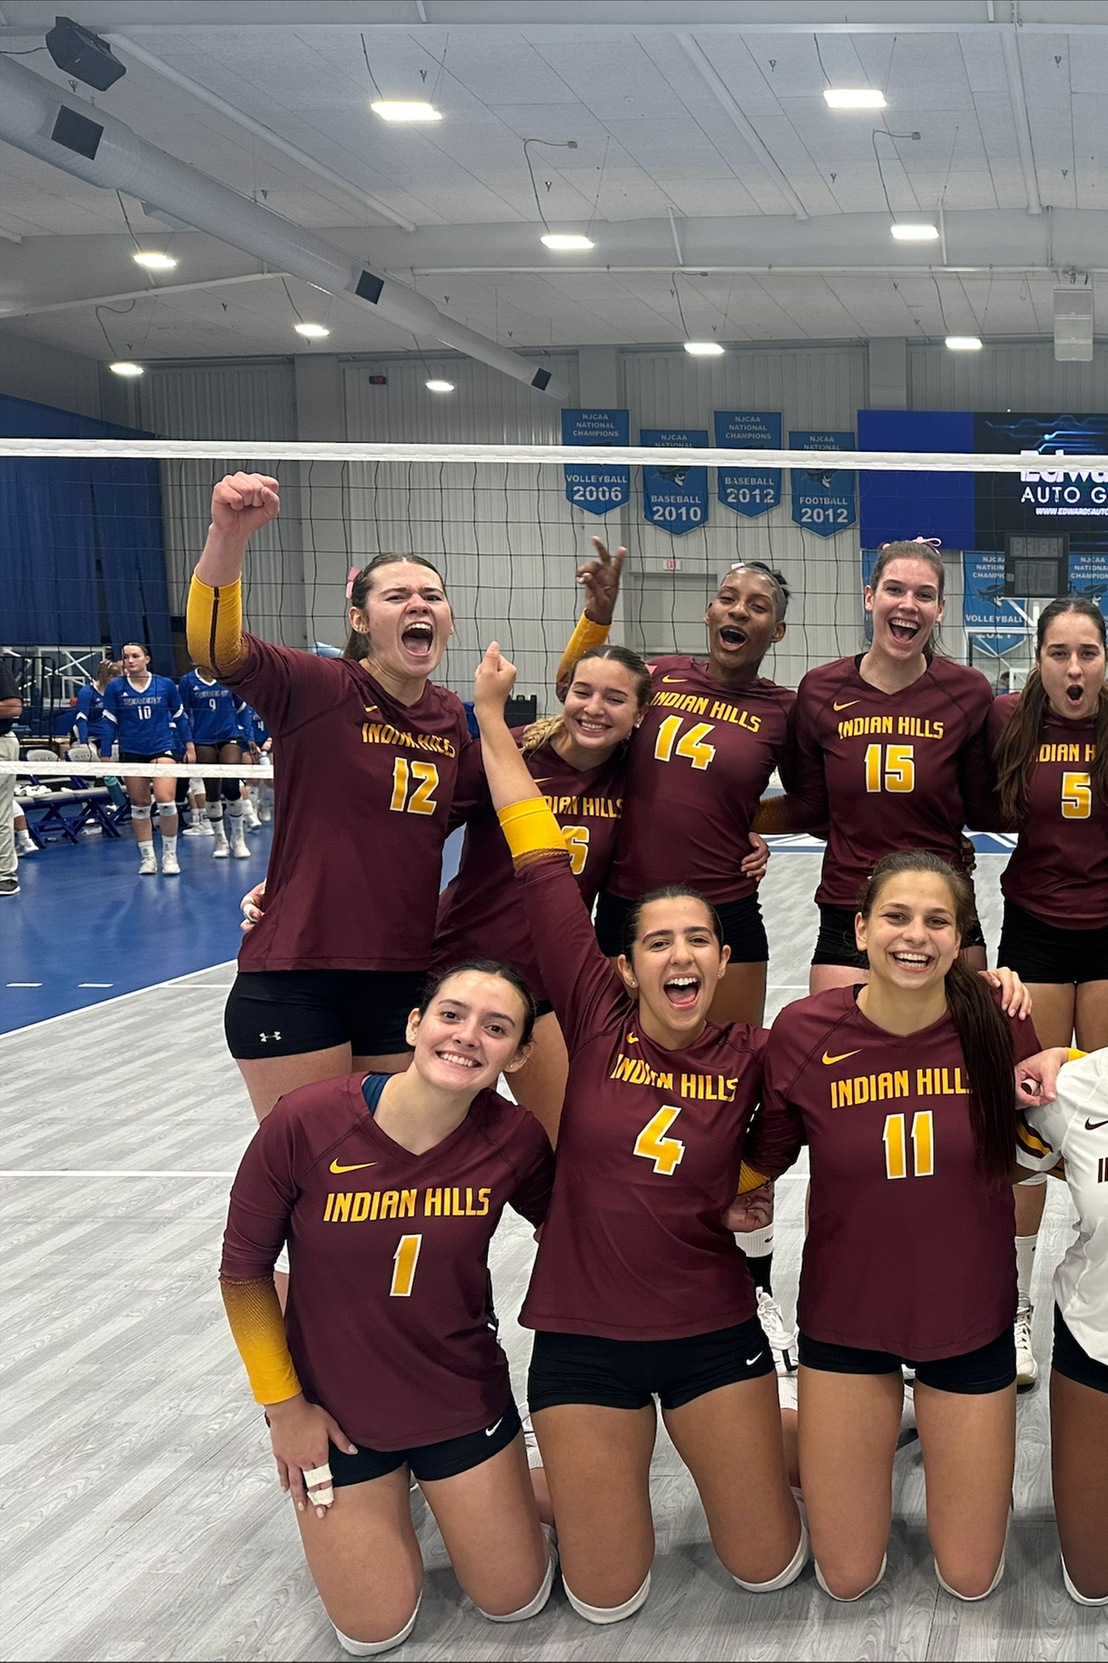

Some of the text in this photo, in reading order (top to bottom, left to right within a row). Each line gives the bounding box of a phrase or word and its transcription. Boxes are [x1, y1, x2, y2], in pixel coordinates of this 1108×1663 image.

[576, 421, 615, 429] NATIONAL
[582, 413, 609, 421] NJCAA
[734, 415, 761, 423] NJCAA
[572, 429, 619, 437] CHAMPIONS
[728, 423, 768, 431] NATIONAL
[660, 433, 688, 441] NJCAA
[725, 432, 772, 440] CHAMPIONS
[809, 435, 835, 443] NJCAA
[566, 474, 628, 483] VOLLEYBALL
[724, 477, 775, 486] BASEBALL
[573, 486, 622, 501] 2006
[651, 494, 701, 504] BASEBALL
[726, 488, 775, 504] 2012
[799, 496, 848, 505] FOOTBALL
[1020, 486, 1081, 504] AUTO
[653, 506, 701, 522] 2010
[800, 508, 849, 524] 2012
[965, 614, 1024, 623] VOLLEYBALL
[138, 705, 152, 720] 10
[208, 698, 217, 711] 9
[651, 691, 762, 733] INDIAN HILLS
[837, 716, 945, 740] INDIAN HILLS
[654, 714, 717, 771] 14
[1036, 743, 1080, 762] DIAN
[863, 743, 915, 793] 15
[389, 757, 440, 816] 12
[1060, 771, 1092, 819] 5
[680, 1073, 740, 1103] HILLS
[829, 1067, 973, 1110] INDIAN HILL
[632, 1104, 686, 1176] 4
[882, 1109, 935, 1180] 11
[323, 1187, 492, 1223] INDIAN HILLS
[389, 1233, 423, 1297] 1
